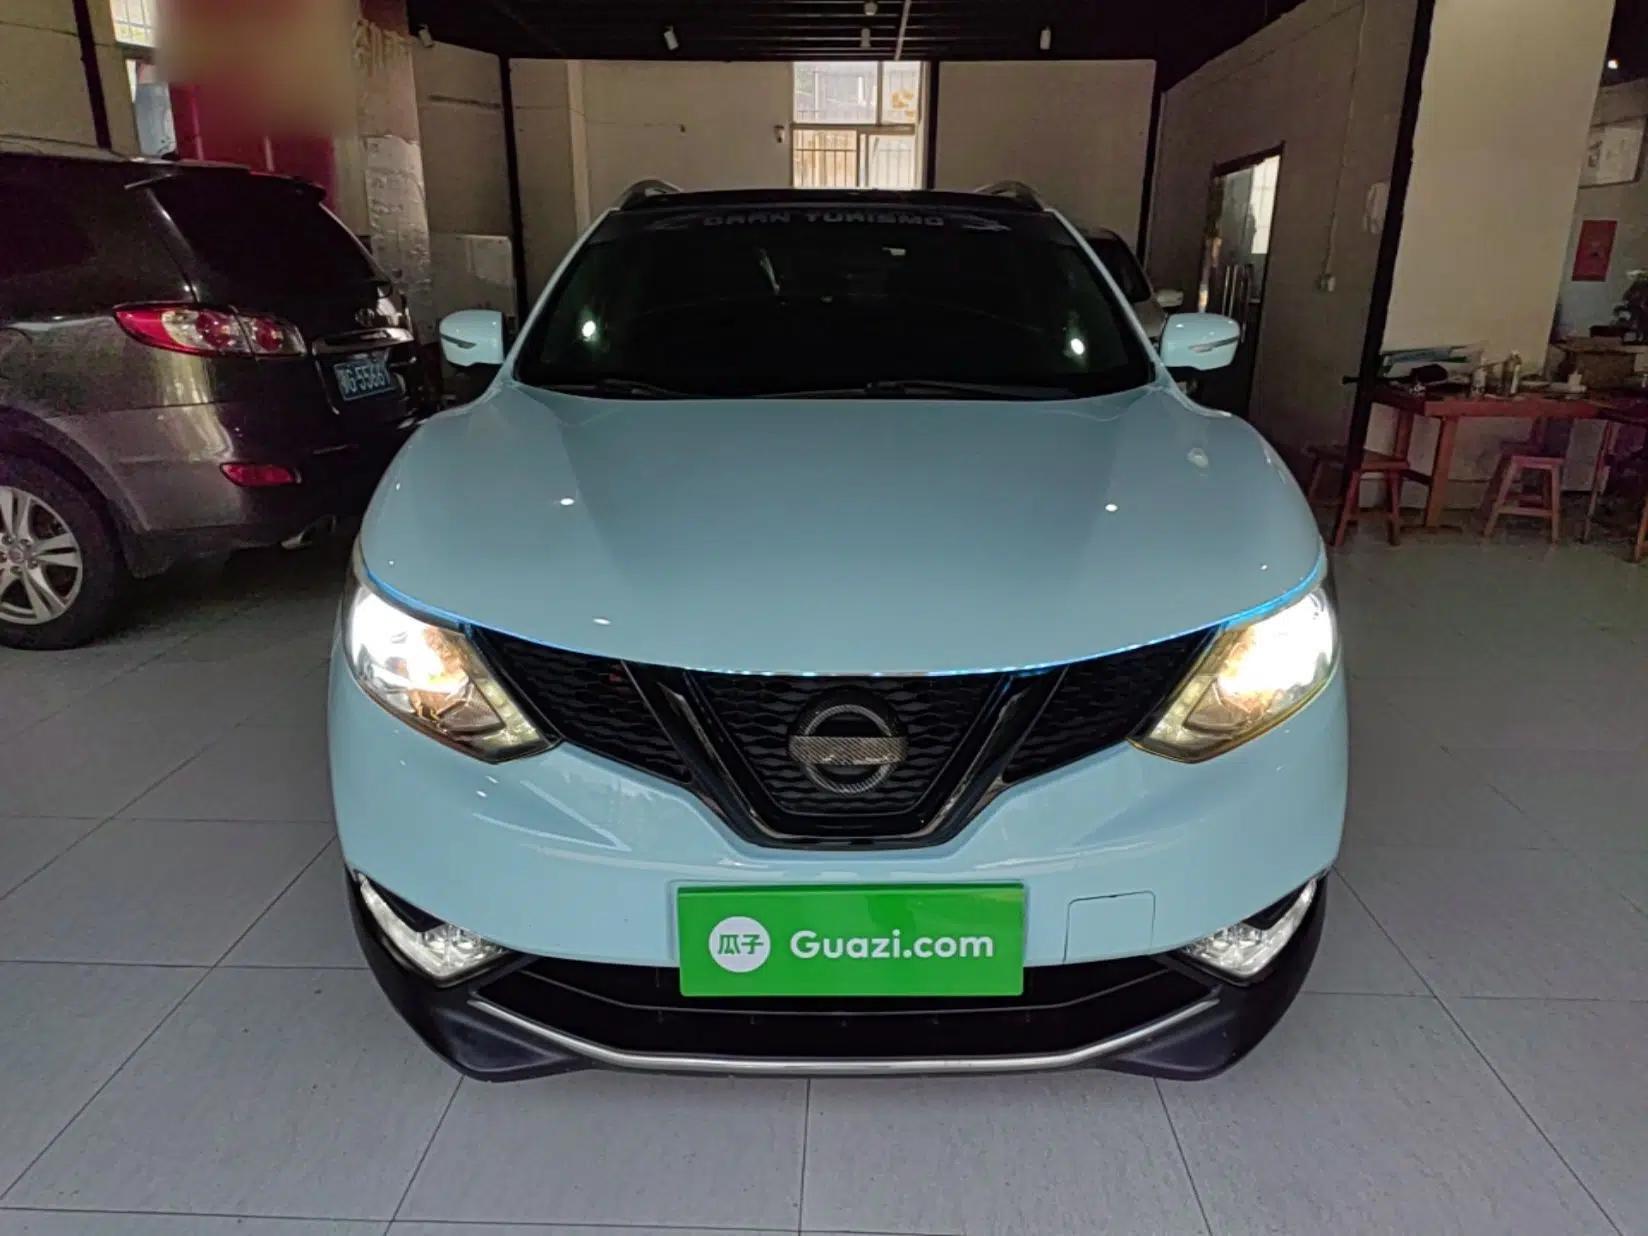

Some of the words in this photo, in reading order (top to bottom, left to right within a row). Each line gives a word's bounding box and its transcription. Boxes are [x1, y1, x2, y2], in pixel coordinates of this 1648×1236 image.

[805, 210, 945, 227] TURISMO
[717, 933, 765, 956] 瓜子
[789, 929, 994, 959] Guazi.com
